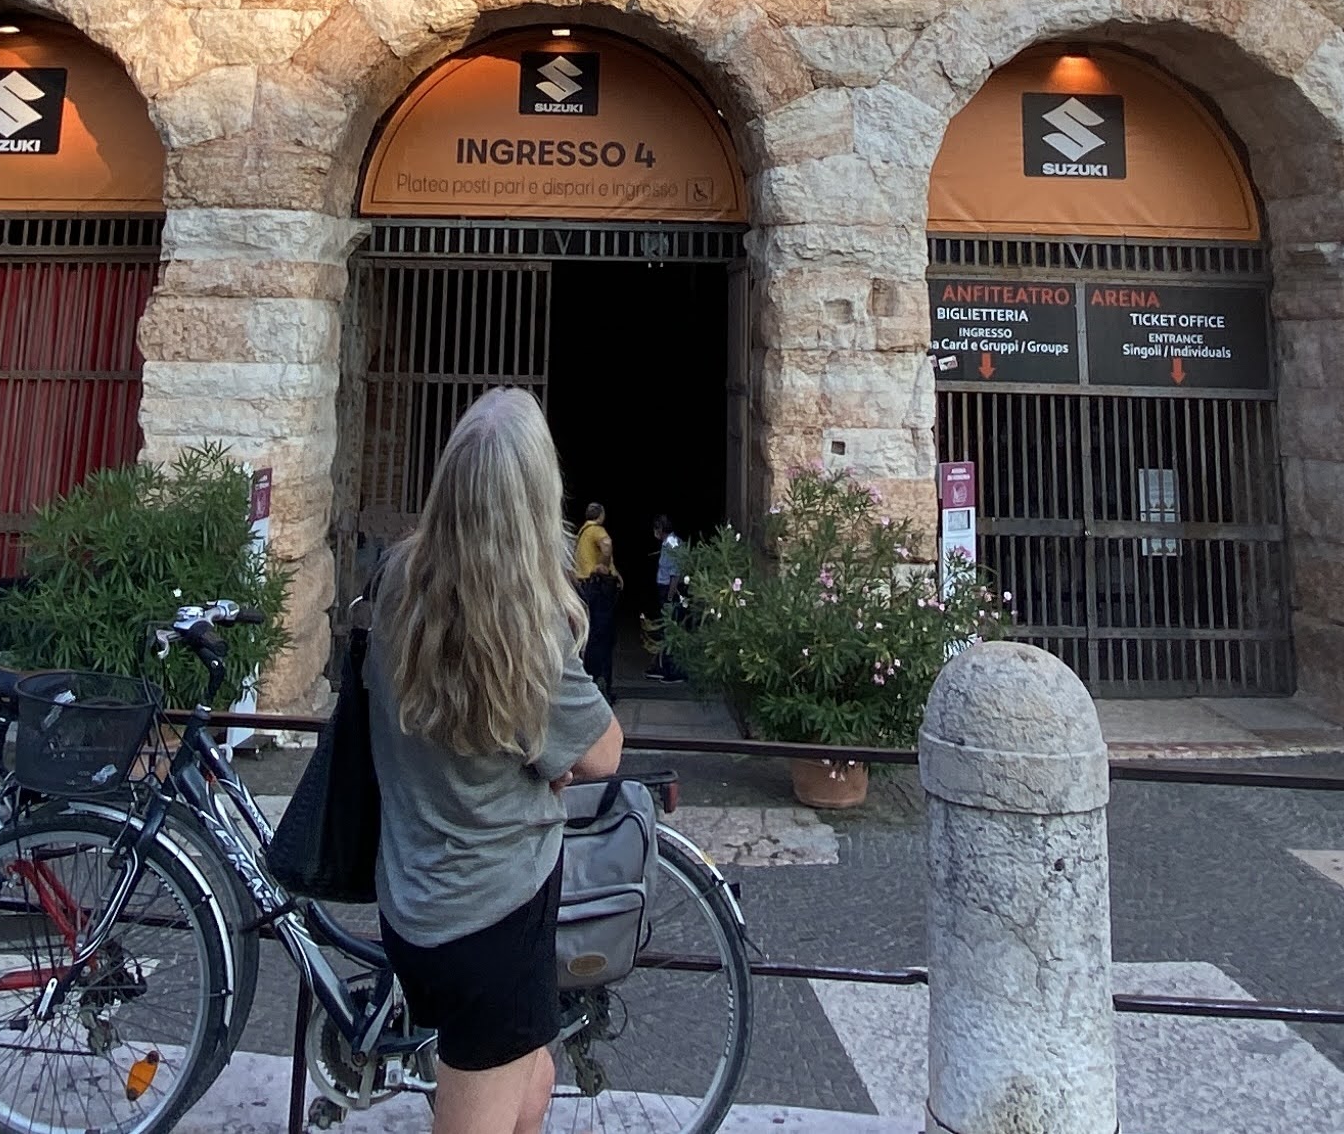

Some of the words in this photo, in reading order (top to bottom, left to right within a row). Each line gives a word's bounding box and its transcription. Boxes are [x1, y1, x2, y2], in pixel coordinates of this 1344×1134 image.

[534, 103, 584, 113] SUZUKI
[457, 138, 626, 167] INGRESSO
[635, 142, 656, 168] 4
[1042, 163, 1108, 177] SUZUKI
[396, 173, 449, 193] Platea
[452, 177, 491, 197] posti
[494, 177, 525, 197] pari
[528, 182, 538, 195] e
[542, 178, 595, 198] dispari
[598, 182, 609, 197] e
[942, 284, 1070, 305] ANFITEATRO
[1091, 289, 1160, 308] ARENA
[936, 307, 1029, 322] BIGLIETTERIA
[1129, 313, 1176, 326] TICKET
[1178, 315, 1225, 328] OFFICE
[958, 328, 1012, 339] INGRESSO
[1148, 333, 1204, 344] ENTRANCE
[941, 339, 969, 350] Card
[970, 342, 978, 351] e
[979, 340, 1019, 354] Gruppi
[1027, 341, 1069, 356] Groups
[1122, 343, 1162, 359] Singoli
[1170, 345, 1231, 358] Individuals
